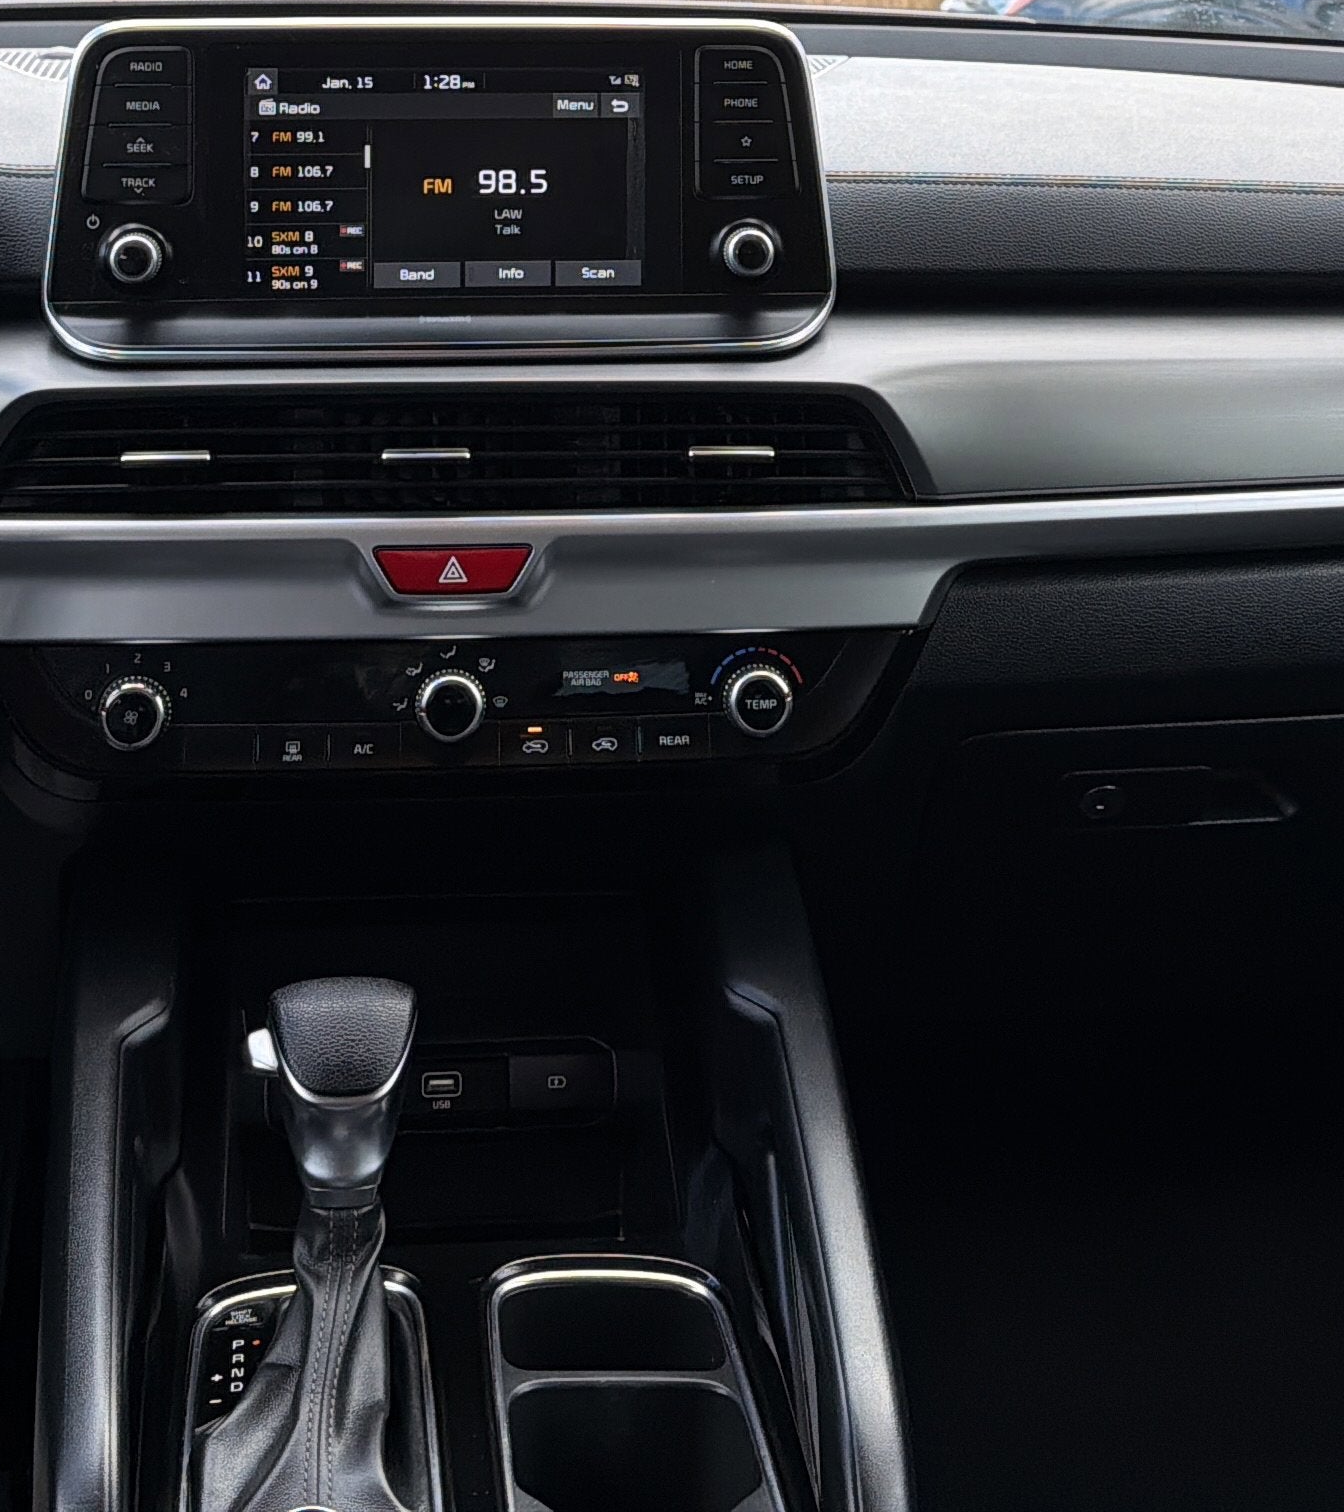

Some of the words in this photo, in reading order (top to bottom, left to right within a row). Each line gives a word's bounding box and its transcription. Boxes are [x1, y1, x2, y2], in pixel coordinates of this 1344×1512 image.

[129, 61, 163, 72] RADIO
[724, 60, 753, 70] HOME
[356, 76, 373, 89] 15
[424, 74, 461, 89] 1:28
[126, 100, 160, 111] MEDIA
[279, 102, 320, 115] Radio
[557, 98, 594, 111] Menu
[724, 98, 759, 108] PHONE
[250, 131, 259, 142] 7
[272, 131, 292, 142] FM
[296, 131, 325, 143] 99.1
[126, 142, 154, 153] SEEK
[250, 166, 259, 178] 8
[272, 166, 292, 178] FM
[297, 166, 334, 178] 106.7
[121, 177, 156, 188] TRACK
[423, 178, 452, 195] FM
[478, 169, 548, 195] 98.5
[731, 175, 764, 185] SETUP
[250, 201, 259, 213] 9
[272, 200, 292, 213] FM
[297, 200, 334, 213] 106.7
[494, 208, 523, 220] LAW
[494, 224, 521, 235] Talk
[247, 235, 263, 248] 10
[271, 231, 300, 243] SXM
[304, 231, 314, 243] 8
[347, 226, 363, 235] REC
[271, 244, 292, 255] 80s
[293, 245, 307, 255] on
[310, 244, 318, 255] 8
[247, 271, 262, 283] 11
[271, 266, 300, 278] SXM
[304, 266, 314, 278] 9
[347, 261, 363, 270] REC
[400, 268, 435, 281] Band
[499, 267, 524, 280] Info
[581, 267, 615, 279] Scan
[271, 279, 292, 290] 90s
[293, 280, 307, 290] on
[310, 279, 318, 290] 9
[133, 653, 142, 664] 2
[104, 663, 110, 674] 1
[163, 661, 171, 673] 3
[562, 670, 610, 680] PASSENGER
[613, 673, 629, 682] OFF
[585, 679, 602, 687] BAG
[84, 689, 93, 701] 0
[179, 688, 188, 699] 4
[694, 697, 707, 706] A/C
[745, 699, 778, 710] TEMP
[659, 735, 690, 746] REAR
[353, 743, 374, 755] A/C
[282, 754, 303, 763] REAR
[432, 1099, 451, 1110] USB
[232, 1339, 245, 1350] P
[232, 1353, 245, 1364] R
[231, 1367, 245, 1378] N
[230, 1381, 244, 1393] D
